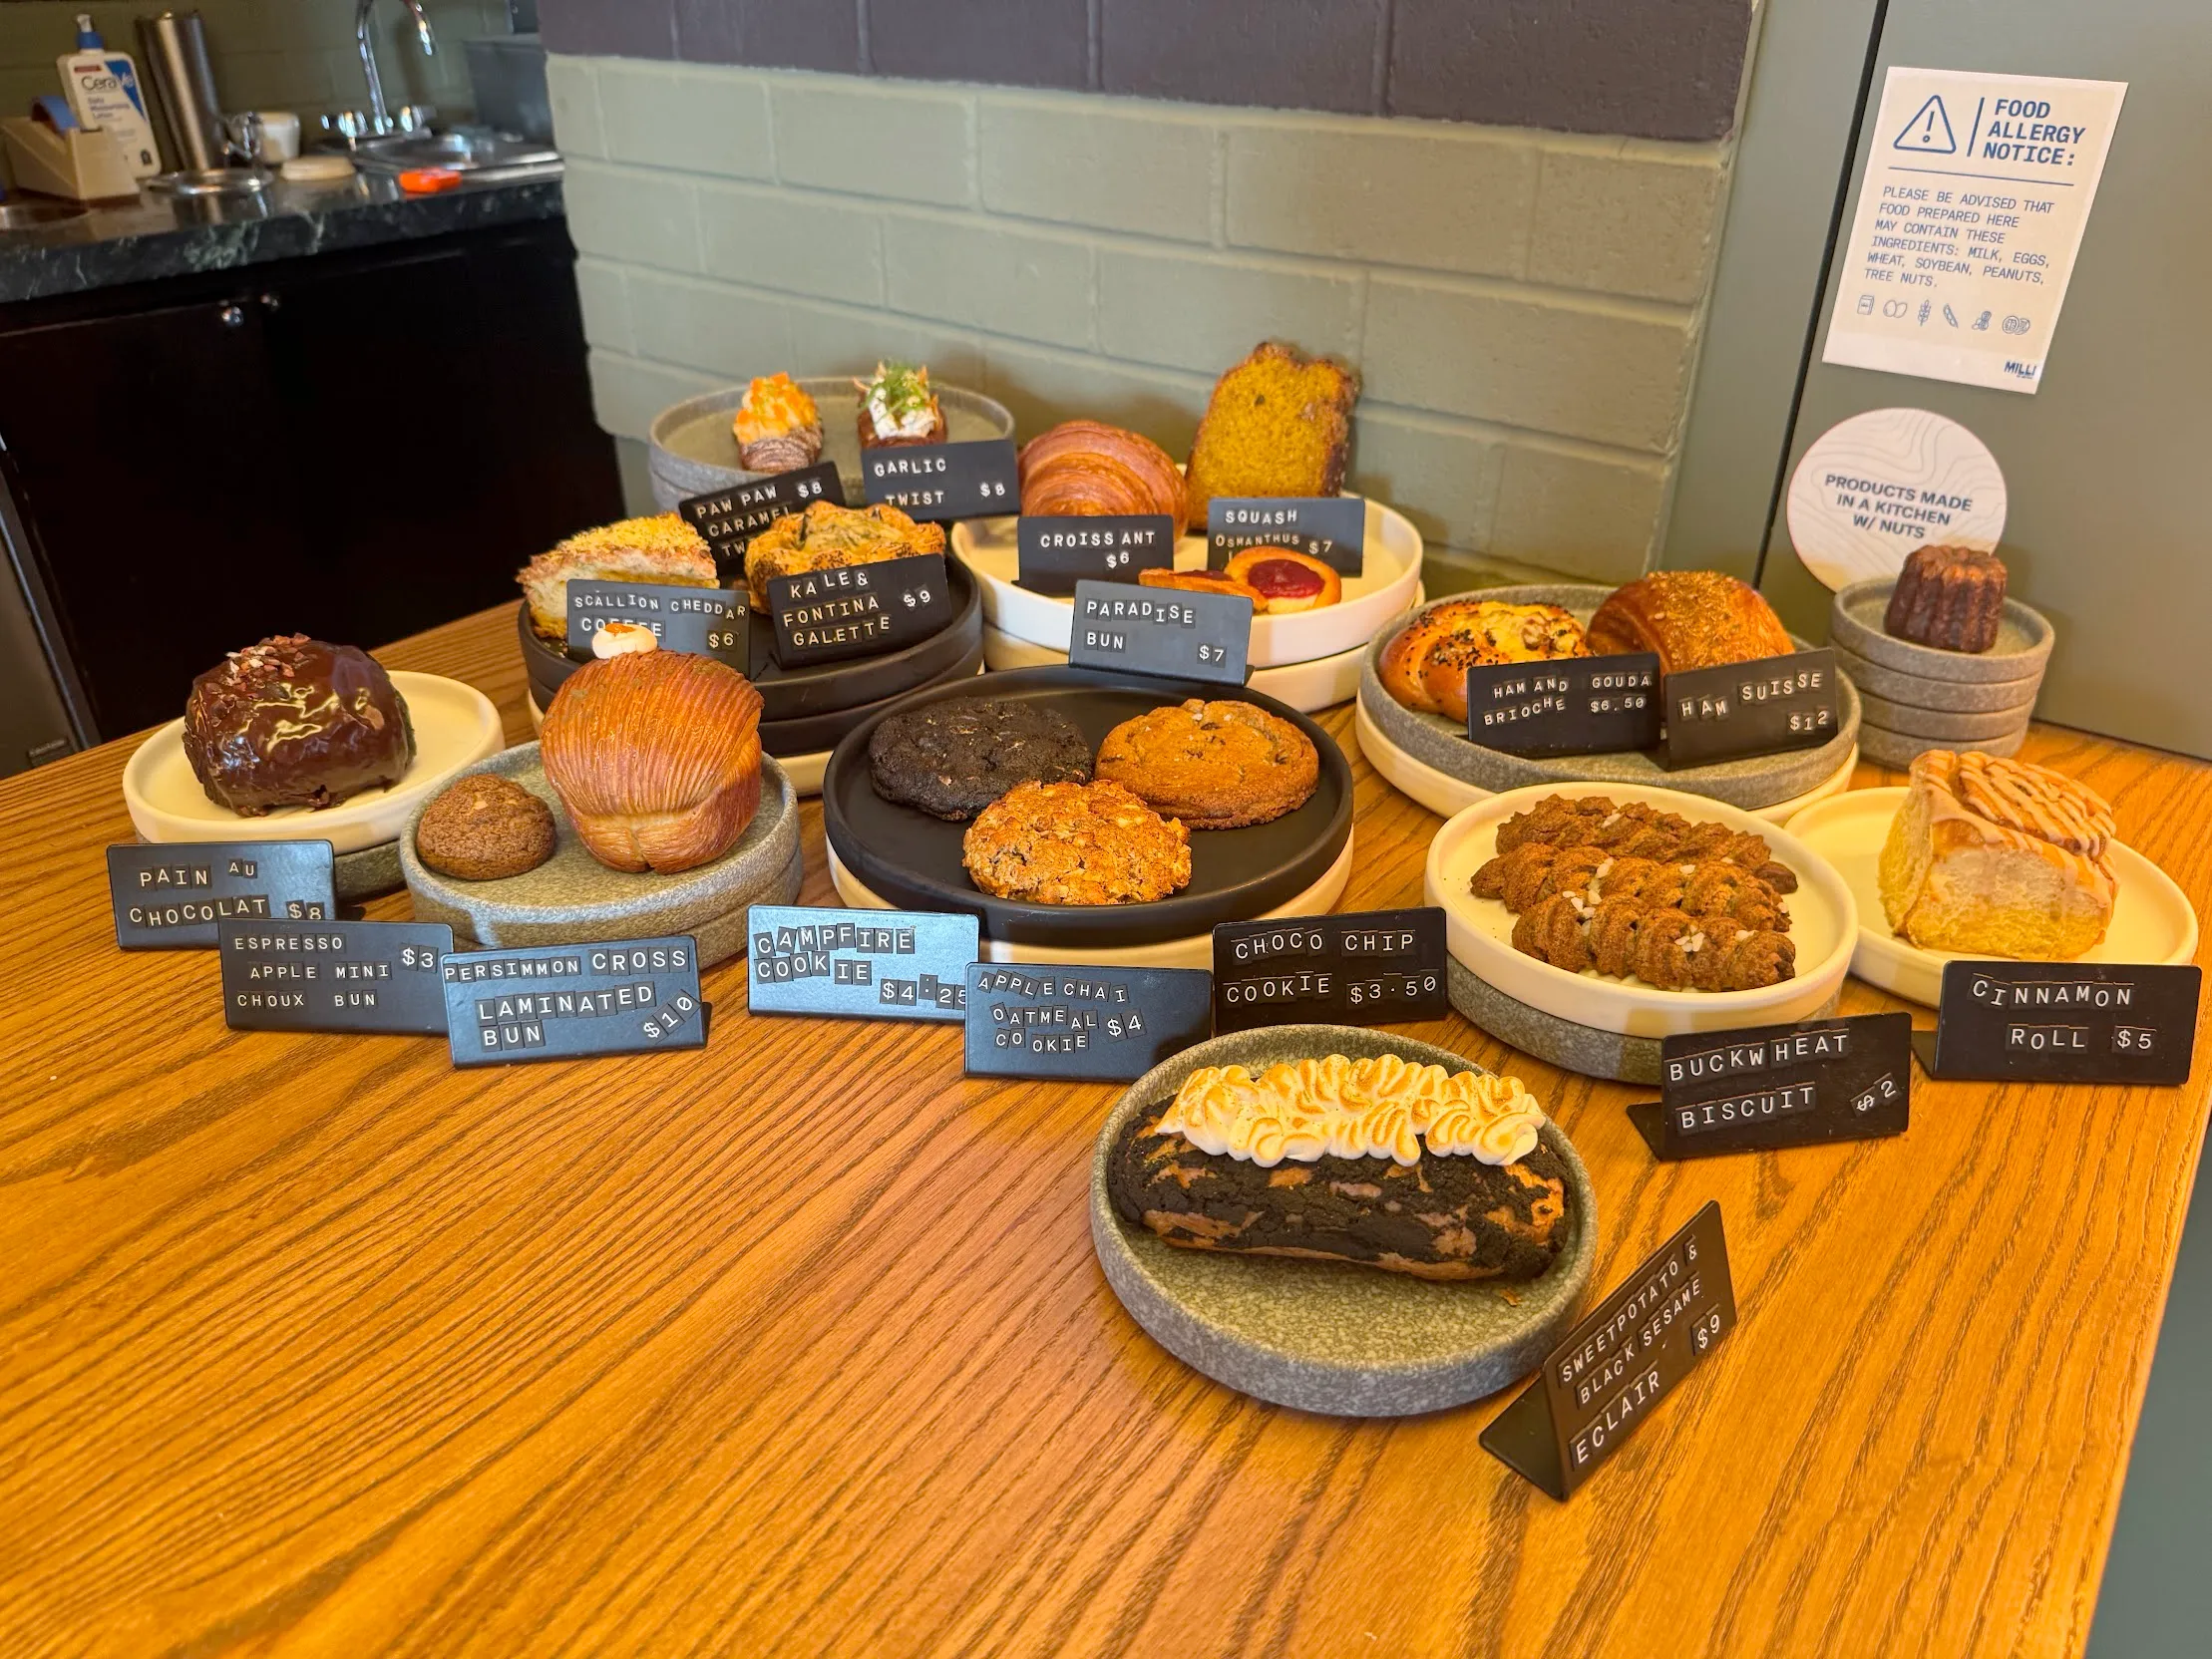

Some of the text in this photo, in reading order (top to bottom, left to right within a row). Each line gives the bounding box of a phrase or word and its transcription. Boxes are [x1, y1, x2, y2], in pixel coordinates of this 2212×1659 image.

[1995, 99, 2050, 119] FOOD
[1988, 122, 2086, 145] ALLERGY
[1983, 143, 2075, 166] NOTICE:
[1883, 186, 2054, 214] PLEASE BE ADVISED THAT
[1879, 203, 2020, 228] FOOD PREPARED HERE
[1875, 220, 2006, 244] MAY CONTAIN THESE
[1872, 236, 2050, 269] INGREDIENTS: MILK, EGGS,
[1864, 269, 1938, 288] TREE NUTS.
[1867, 252, 2044, 285] WHEAT, SOYBEAN, PEANUTS,
[874, 458, 946, 477] GARLIC
[696, 482, 822, 518] PAW PAW $8
[886, 482, 1005, 505] TWIST $8
[1825, 474, 1973, 511] PRODUCTS MADE
[1226, 509, 1296, 524] SQUASH
[1836, 494, 1951, 526] IN A KITCHEN
[1040, 530, 1155, 548] CROISSANT
[1853, 514, 1926, 539] W/ NUTS
[1216, 534, 1332, 554] OSMANTHUS $7
[1106, 551, 1129, 568] $6
[574, 594, 746, 620] SCALLION CHEDDAR
[783, 588, 931, 627] FONTINA $9
[1087, 602, 1194, 624] PARADISE
[708, 633, 734, 649] $6
[793, 616, 890, 647] GALETTE
[1087, 633, 1224, 662] BUN $7
[1494, 675, 1652, 699] HAM AND GOUDA
[1681, 673, 1822, 717] HAM SUISSE
[1484, 697, 1645, 726] BRIOCHE $6.50
[1789, 711, 1828, 731] $12
[140, 862, 255, 887] PAIN AU
[130, 898, 321, 925] CHOCOLAT $8
[235, 937, 433, 968] ESPRESSO $3
[758, 926, 911, 953] CAMPFIRE
[1235, 932, 1413, 960] CHOCO CHIP
[250, 964, 389, 979] APPLE MINI
[445, 950, 686, 980] PERSIMMON CROSS
[758, 955, 867, 978] COOKIE
[237, 993, 375, 1007] CHOUX BUN
[979, 975, 1124, 1003] APPLE CHAI
[1228, 975, 1329, 1003] COOKIE
[1973, 980, 2131, 1008] CINNAMON
[480, 986, 652, 1020] LAMINATED
[484, 996, 693, 1047] BUN $10
[994, 1008, 1141, 1037] OATMEAL $4
[996, 1032, 1086, 1052] COOKIE
[2011, 1028, 2151, 1050] ROLL $5
[1670, 1034, 1848, 1082] BUCKWHEAT
[1681, 1080, 1896, 1130] BISCUIT $2
[1562, 1244, 1697, 1382] SWEETPOTATO &
[1580, 1279, 1700, 1405] BLACK SESAME
[1576, 1314, 1720, 1464] ECLAIR $9
